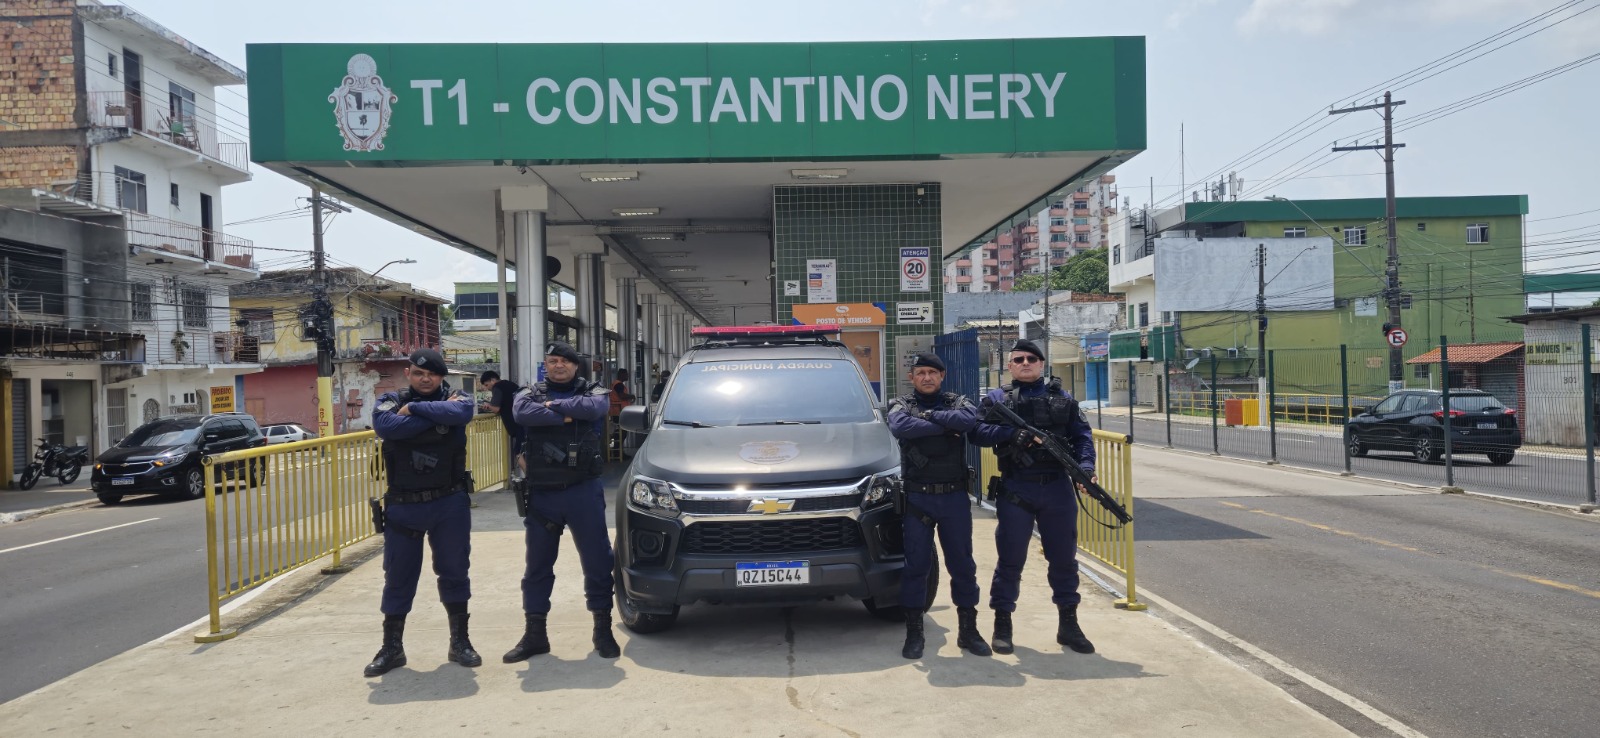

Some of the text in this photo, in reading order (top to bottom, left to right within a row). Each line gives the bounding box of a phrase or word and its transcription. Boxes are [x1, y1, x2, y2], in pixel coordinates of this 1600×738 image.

[410, 72, 1066, 125] T1 - CONSTANTINO NERY
[907, 263, 923, 274] 20
[1535, 343, 1560, 354] MÓVEIS
[743, 569, 802, 584] QZI5C44
